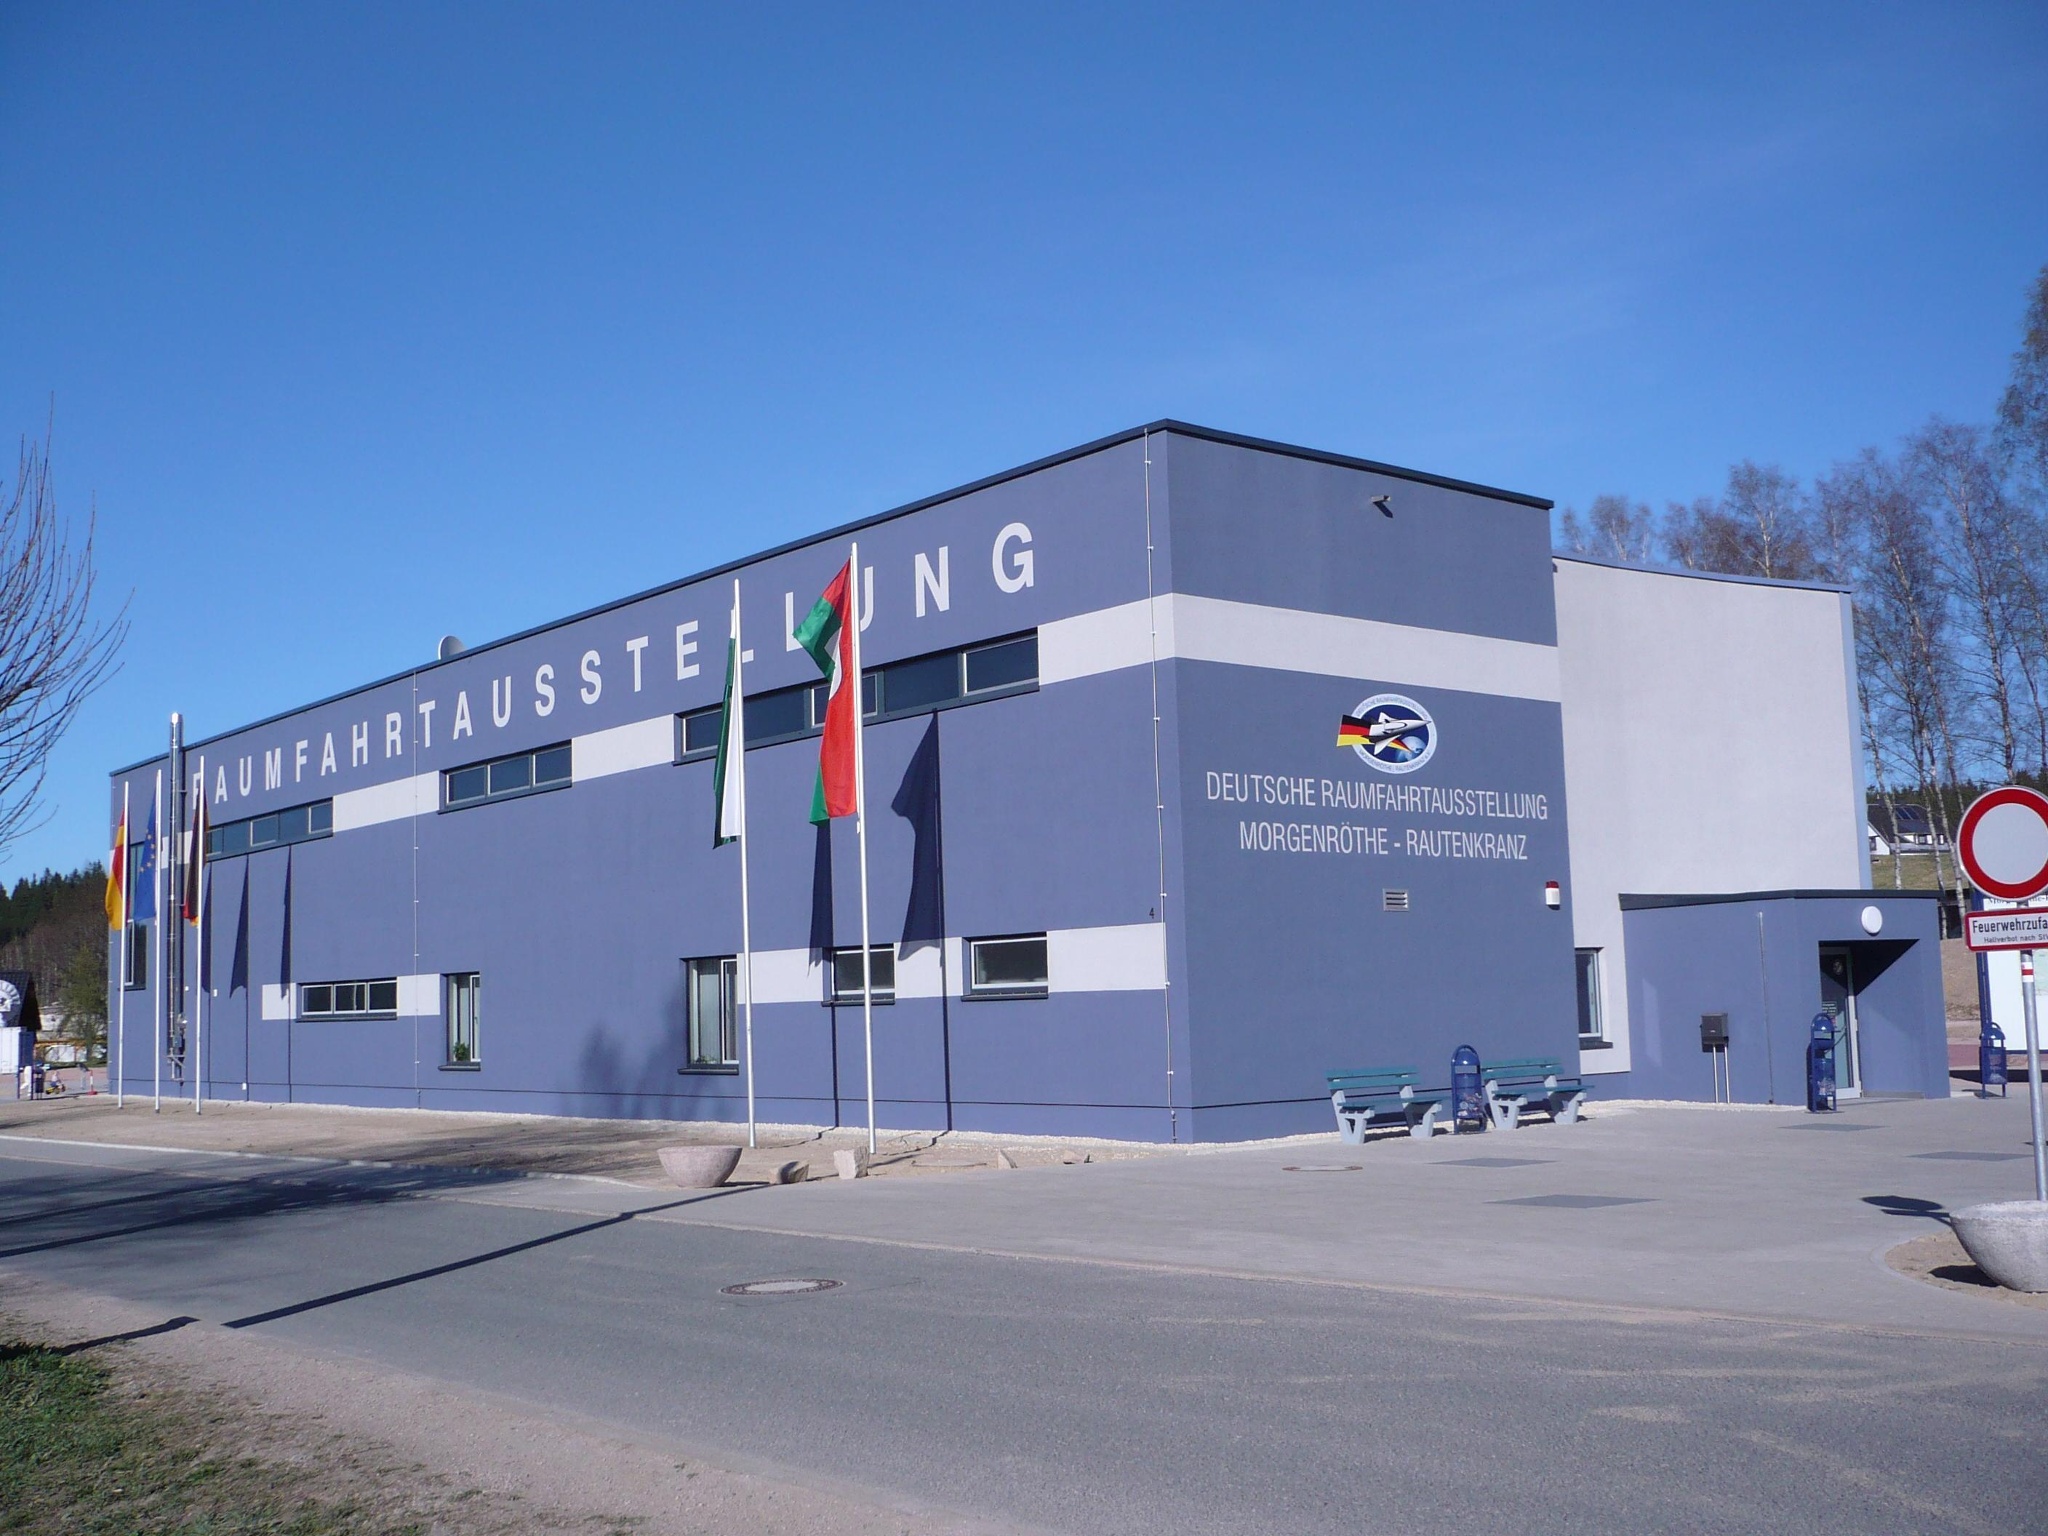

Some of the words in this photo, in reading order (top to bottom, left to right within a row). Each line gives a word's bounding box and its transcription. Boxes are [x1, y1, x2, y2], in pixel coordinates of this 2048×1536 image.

[192, 522, 1034, 810] RAUMFAHRTAUSSTELNG
[1206, 771, 1316, 806] DEUTSCHE
[1321, 779, 1548, 820] RAUMFAHRTAUSSTELLUNG
[1240, 821, 1389, 855] MORGENRÖTHE
[1406, 828, 1528, 860] RAUTENKRANZ
[1972, 916, 2048, 934] Feuerwehrzufa
